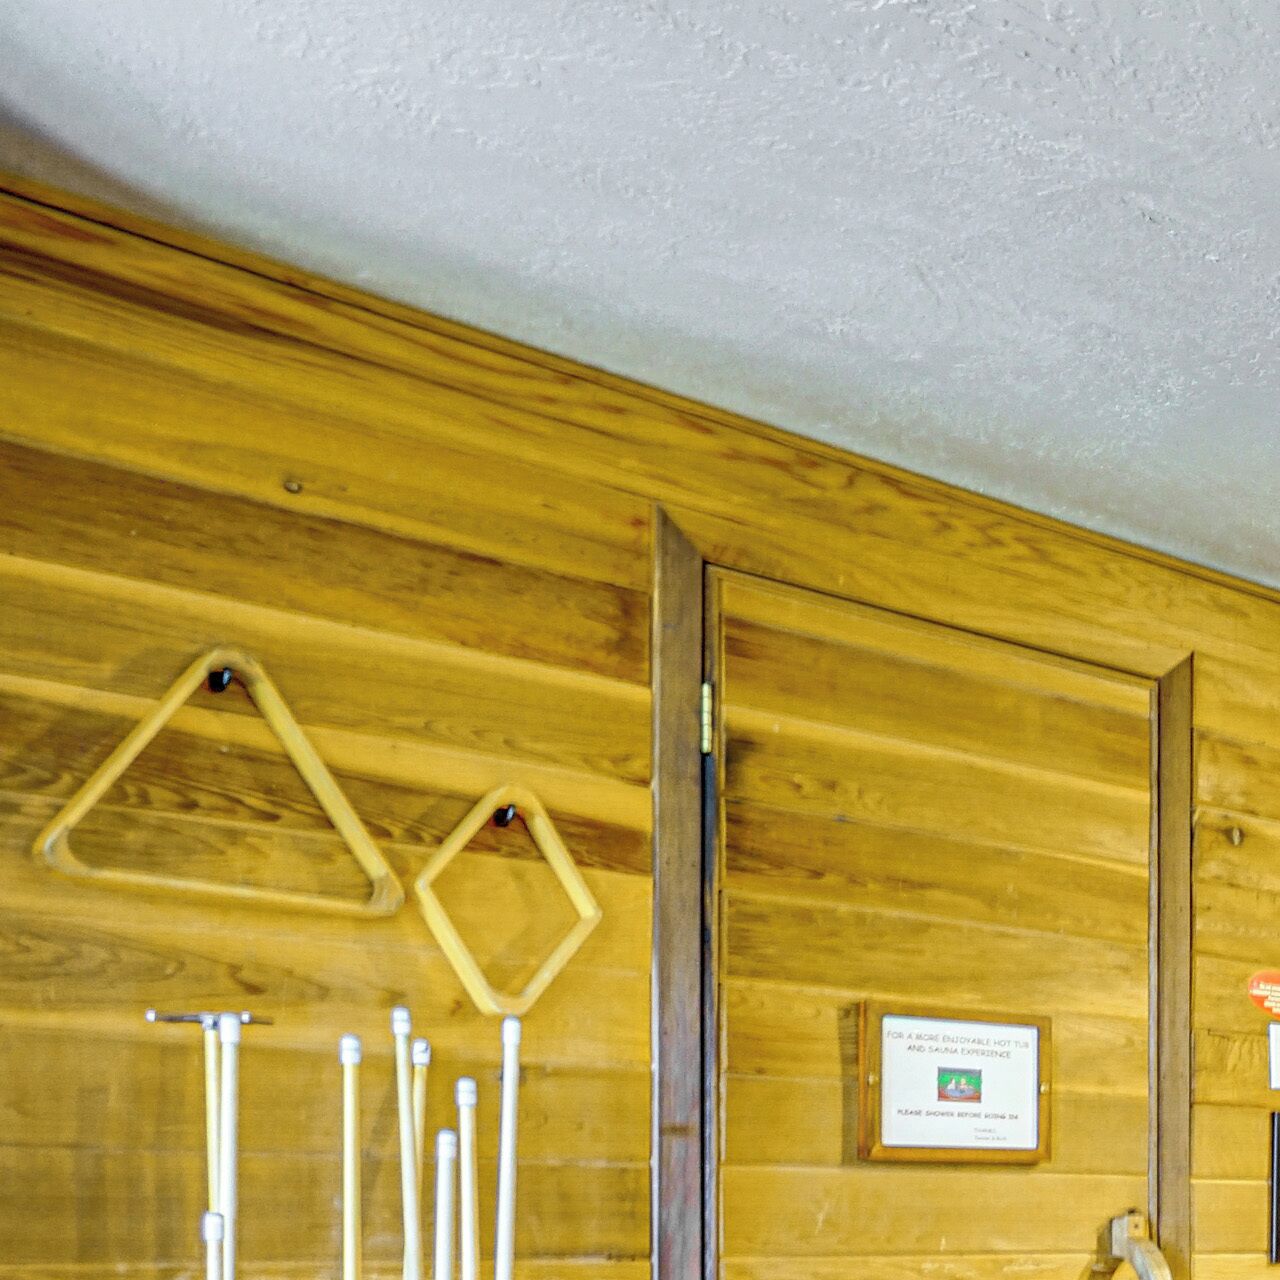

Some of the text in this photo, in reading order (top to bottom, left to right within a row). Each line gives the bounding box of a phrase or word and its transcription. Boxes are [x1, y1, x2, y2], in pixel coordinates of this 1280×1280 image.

[886, 1030, 1030, 1049] FOR A MORE ENJOYABLE HOT TUB
[907, 1044, 1011, 1059] AND SAUNA EXPERIENCE
[897, 1108, 922, 1117] PLEASE
[925, 1109, 954, 1118] SHOWER
[957, 1111, 982, 1120] BEFORE
